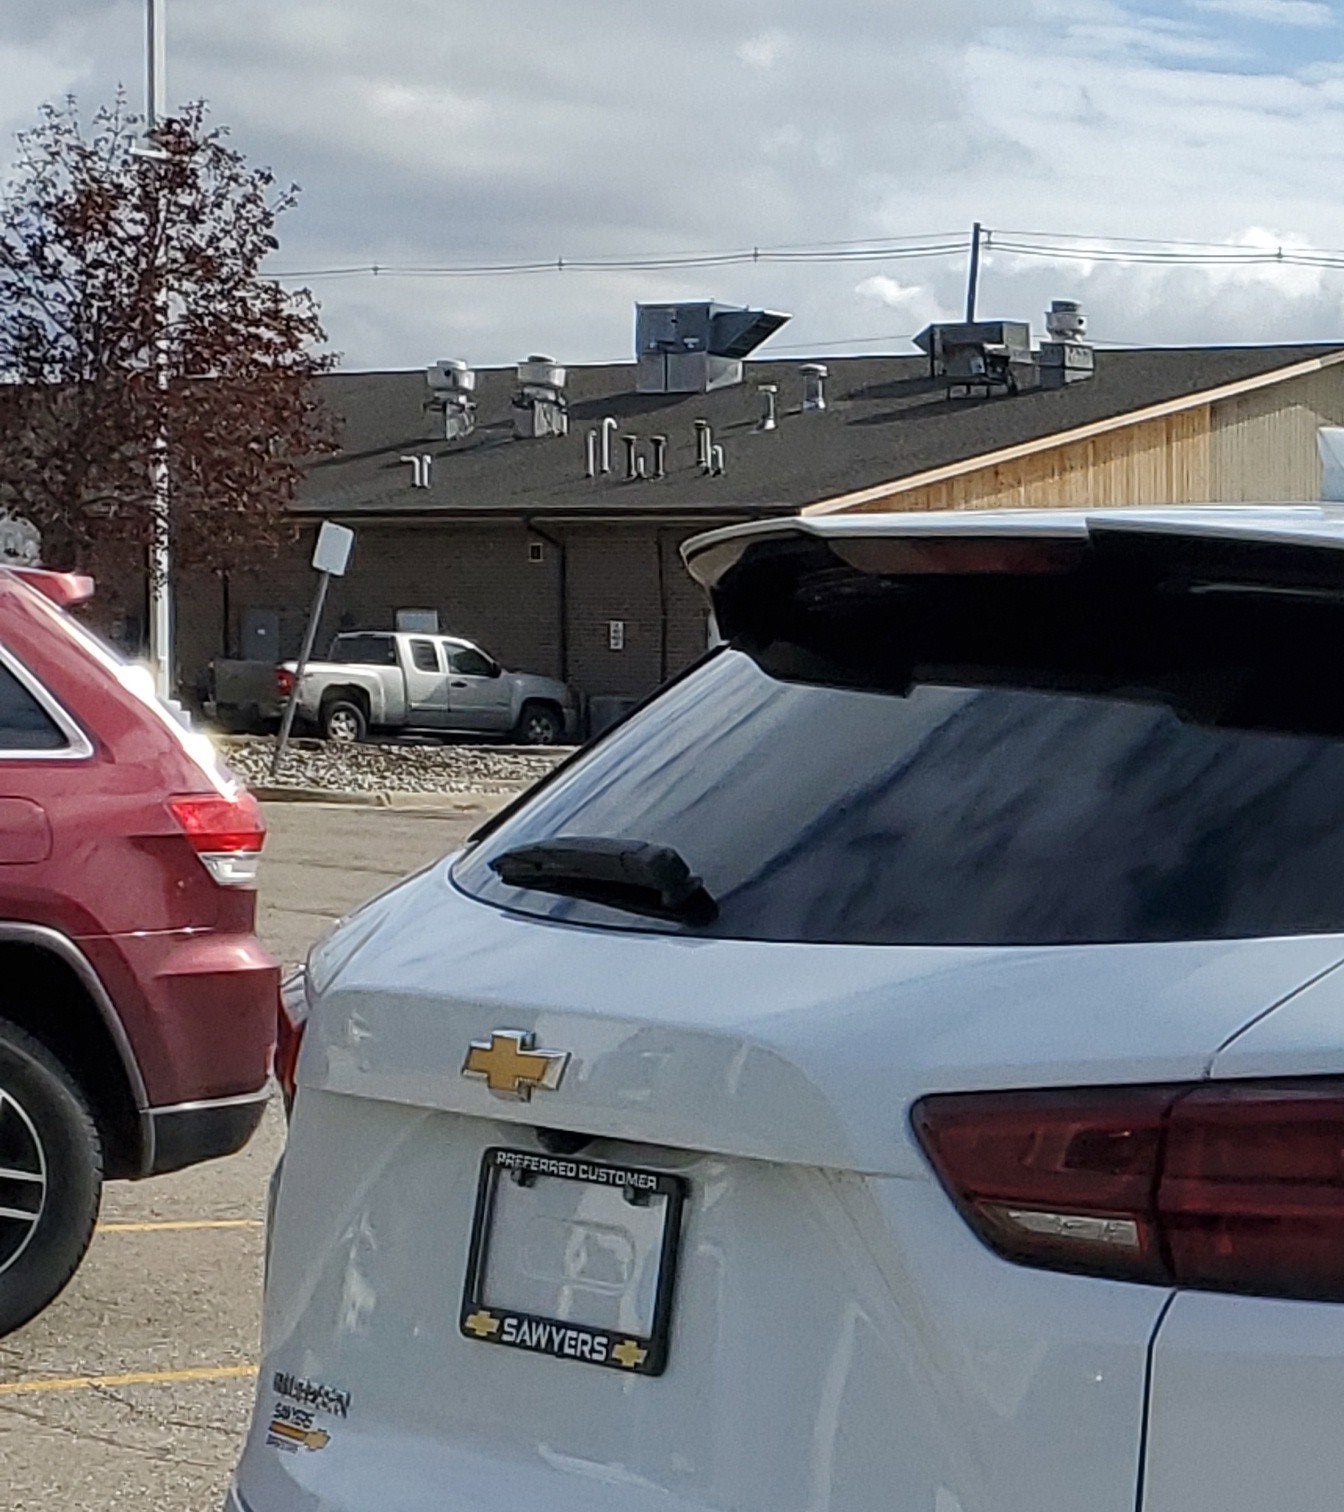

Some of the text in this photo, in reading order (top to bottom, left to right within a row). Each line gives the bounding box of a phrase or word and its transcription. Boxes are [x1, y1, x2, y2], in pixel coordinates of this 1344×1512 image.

[496, 1151, 658, 1190] PREFERRED CUSTOMER
[501, 1317, 609, 1362] SAWYERS
